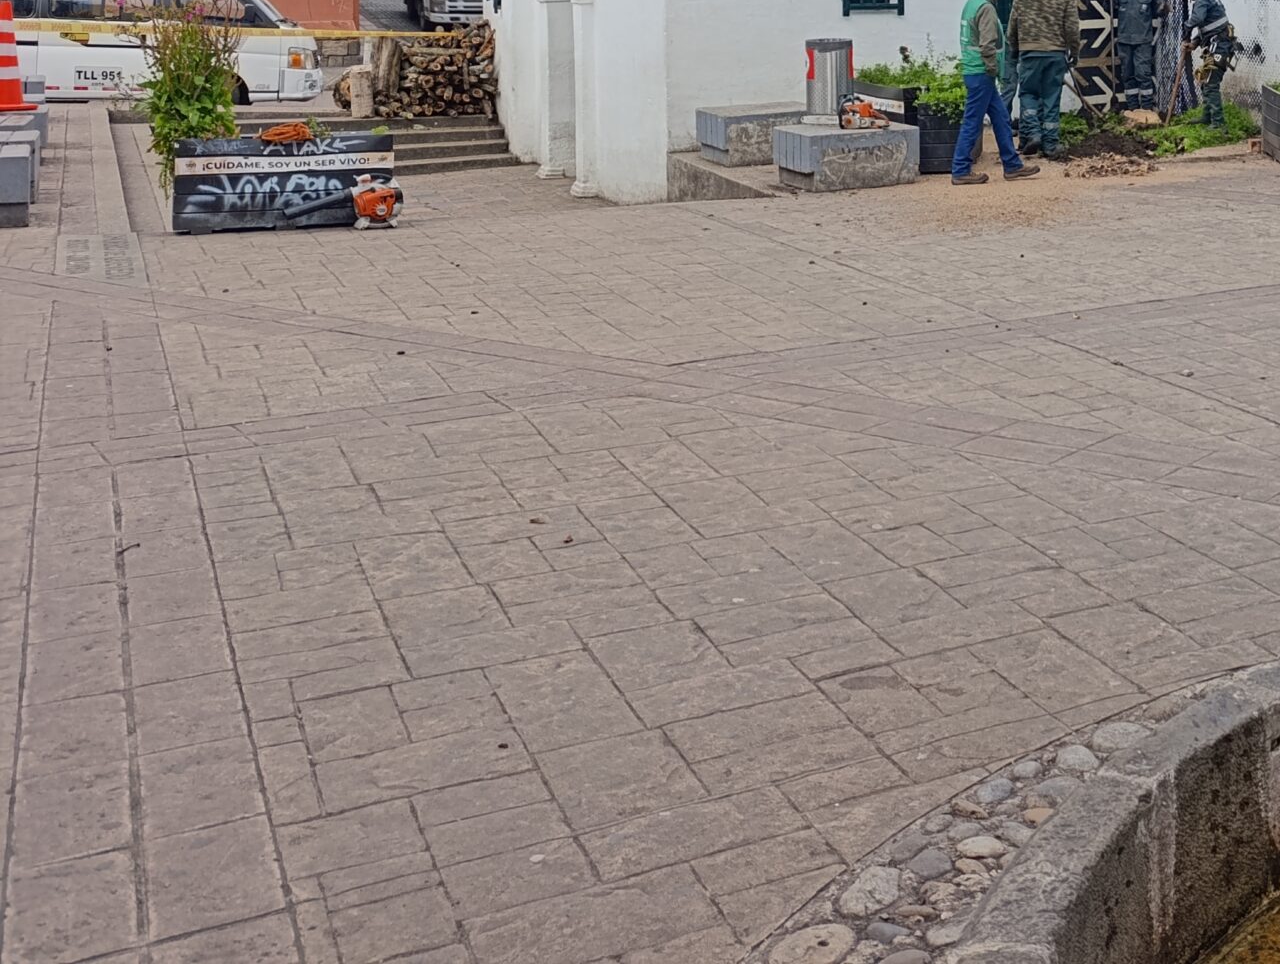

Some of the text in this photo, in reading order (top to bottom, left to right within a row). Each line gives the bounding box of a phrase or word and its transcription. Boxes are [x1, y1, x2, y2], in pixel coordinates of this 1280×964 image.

[76, 70, 97, 80] TLL
[202, 157, 370, 171] ¡CUÍDAME, SOY UN SER VIVO!
